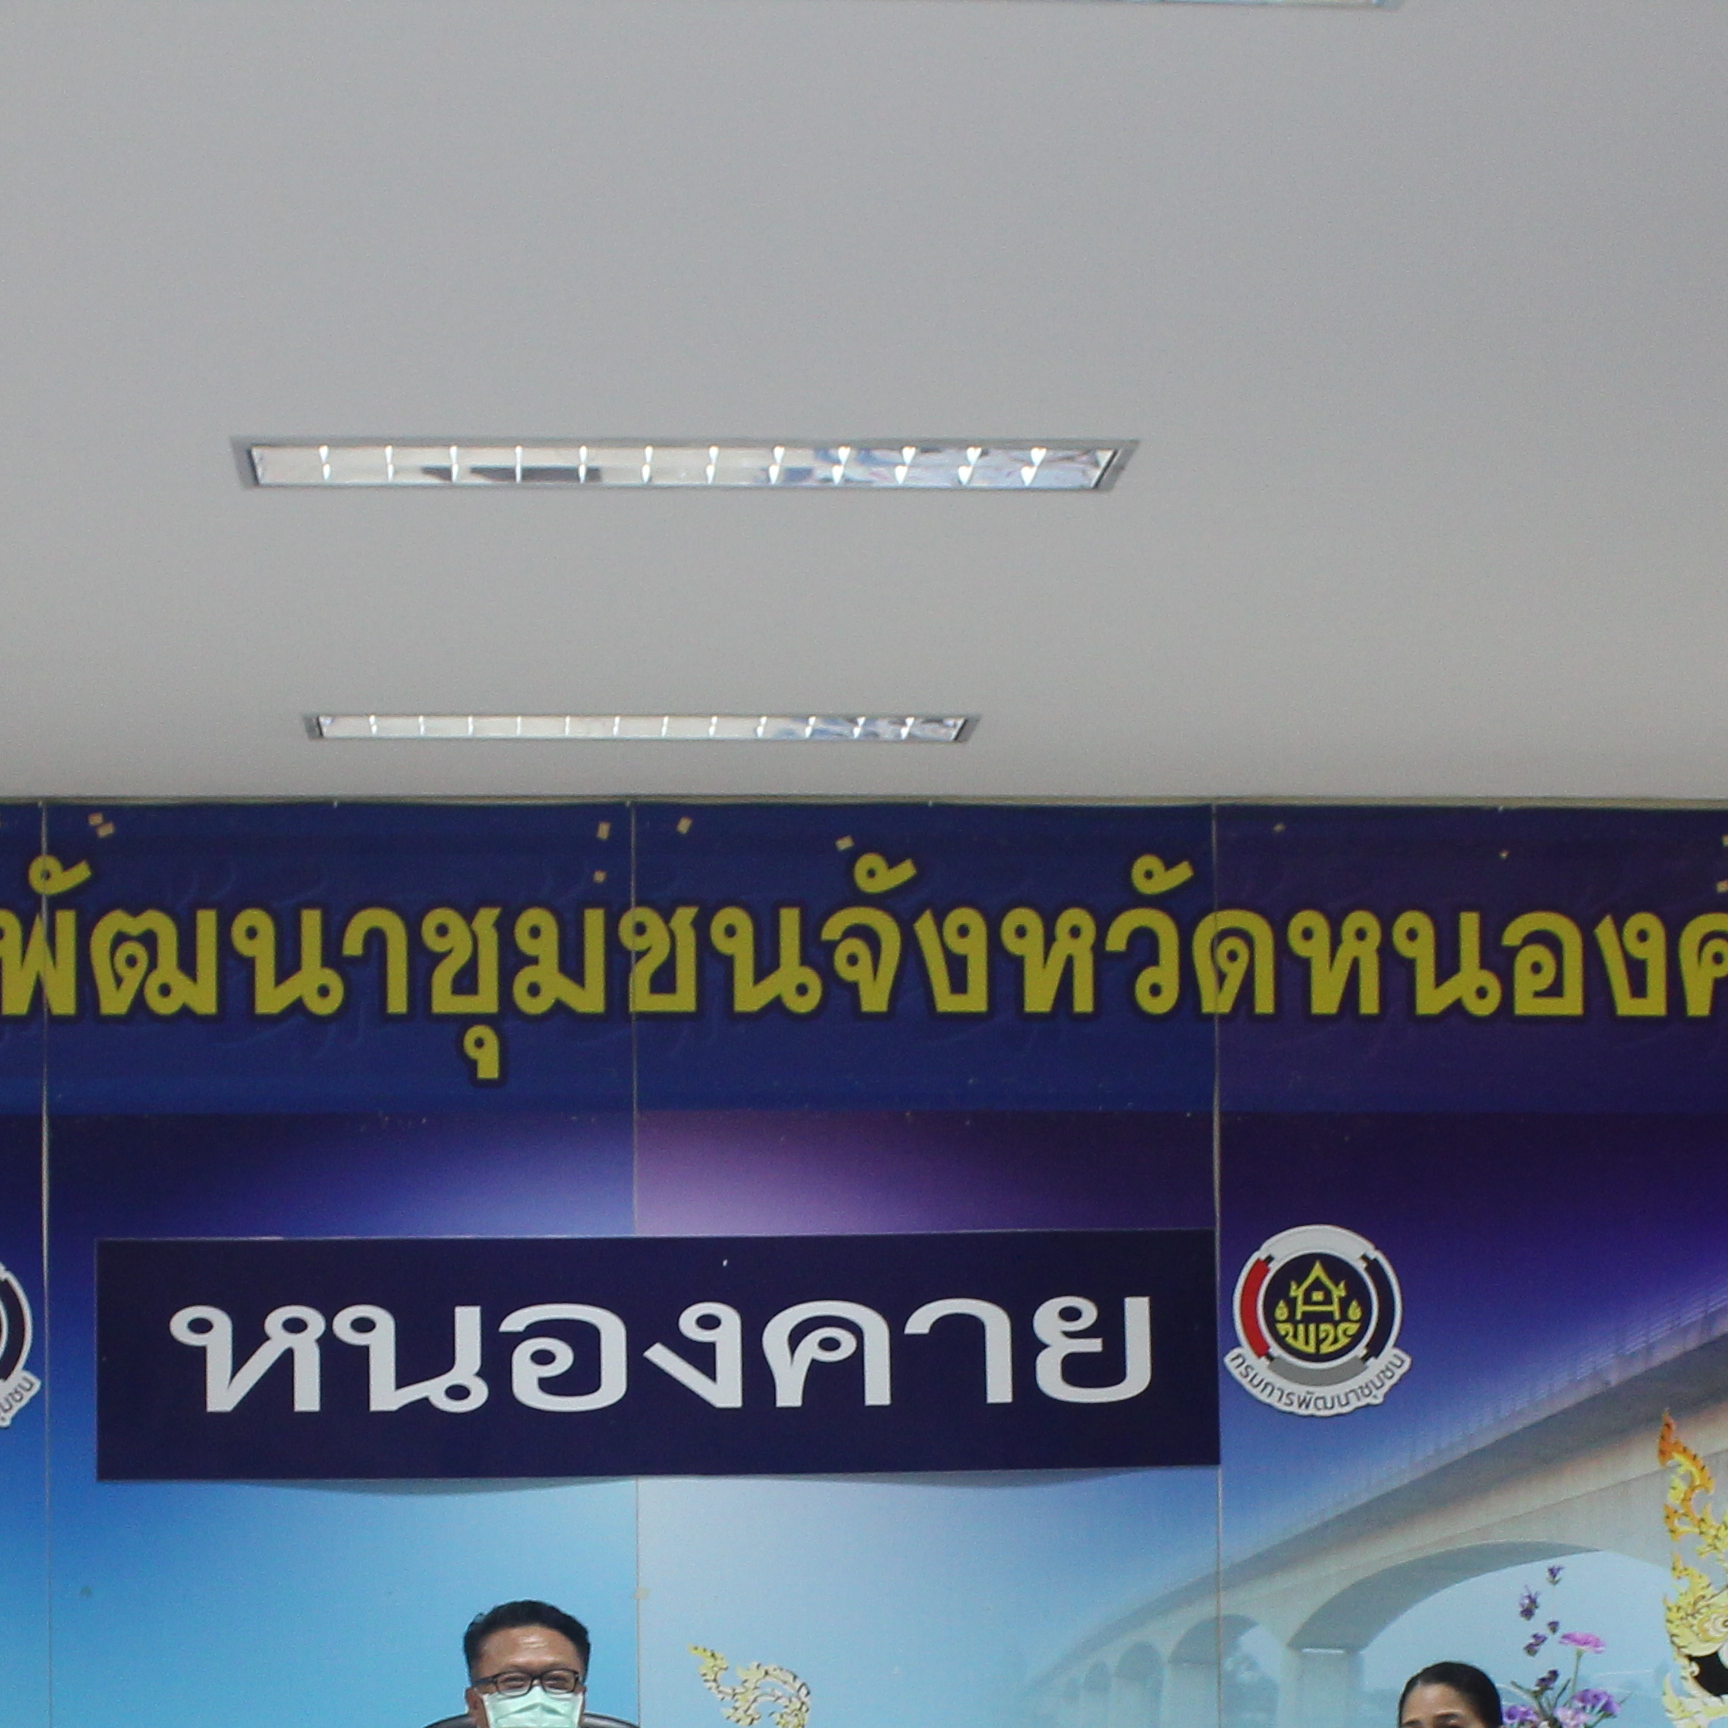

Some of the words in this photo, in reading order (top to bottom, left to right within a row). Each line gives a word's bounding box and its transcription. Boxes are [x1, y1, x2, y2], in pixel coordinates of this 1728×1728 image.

[170, 1297, 1150, 1412] หนองคาย
[1228, 1352, 1406, 1411] กรมการพัฒนาชุมชน
